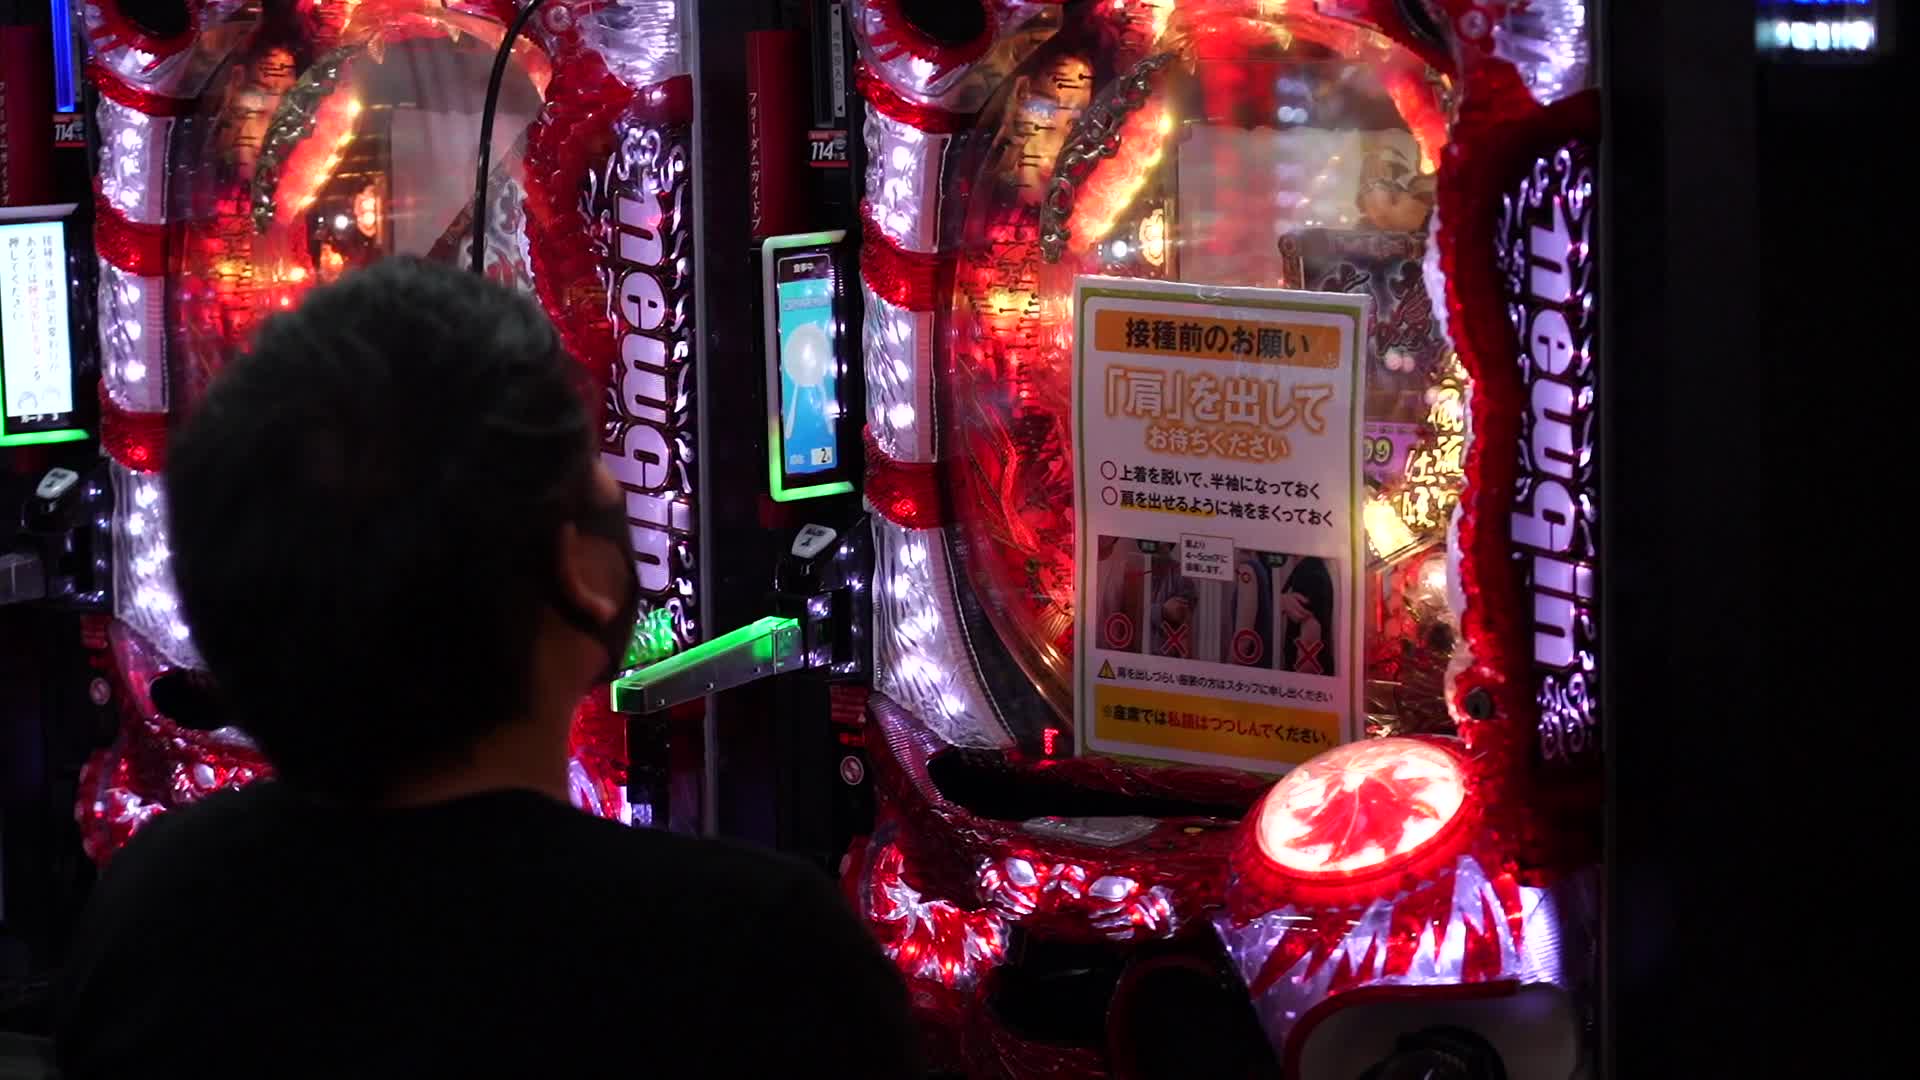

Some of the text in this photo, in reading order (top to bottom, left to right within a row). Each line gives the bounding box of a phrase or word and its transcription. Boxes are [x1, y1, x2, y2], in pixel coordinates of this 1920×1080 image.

[54, 123, 75, 141] 114
[811, 141, 835, 161] 114
[1125, 317, 1310, 359] 接種前のお願い
[1104, 364, 1334, 435] 「肩」を出して
[1147, 426, 1289, 461] お待ちください
[1119, 464, 1320, 500] 上着を脱いで、半袖になっておく
[1120, 490, 1334, 528] 肩を出せるように袖をまくっておく
